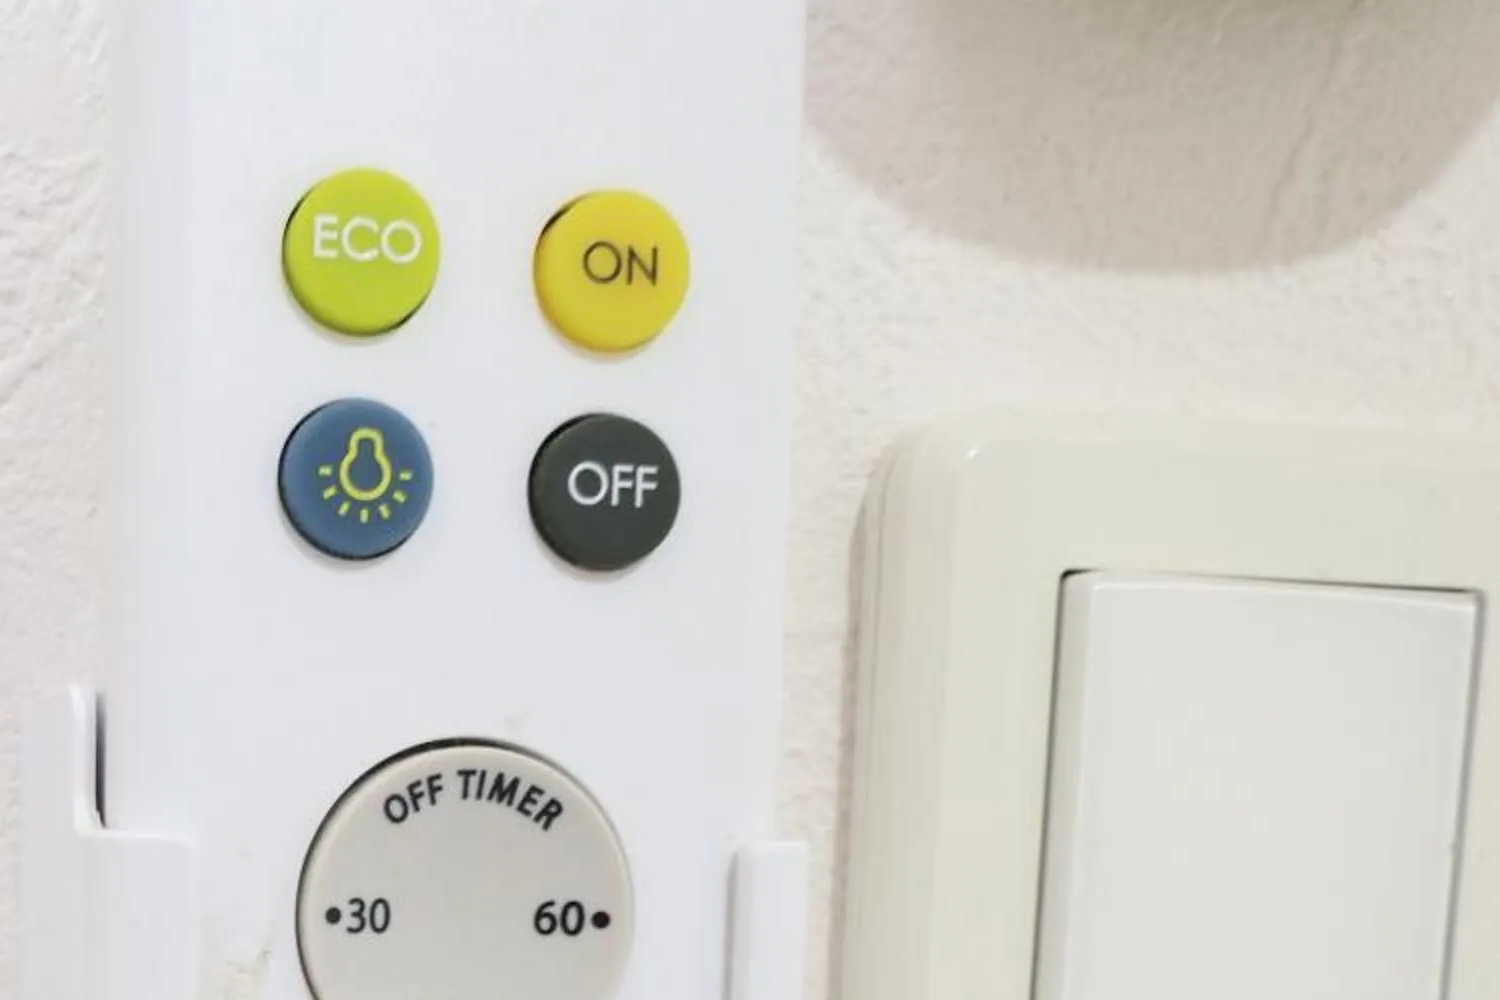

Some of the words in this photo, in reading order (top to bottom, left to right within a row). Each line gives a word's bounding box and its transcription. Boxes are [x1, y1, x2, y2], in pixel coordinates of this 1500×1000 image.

[312, 214, 423, 263] ECO
[583, 241, 658, 286] ON
[568, 461, 657, 508] OFF
[383, 773, 444, 825] OFF
[457, 769, 563, 831] TIMER
[347, 898, 390, 934] 30
[534, 901, 585, 936] 60
